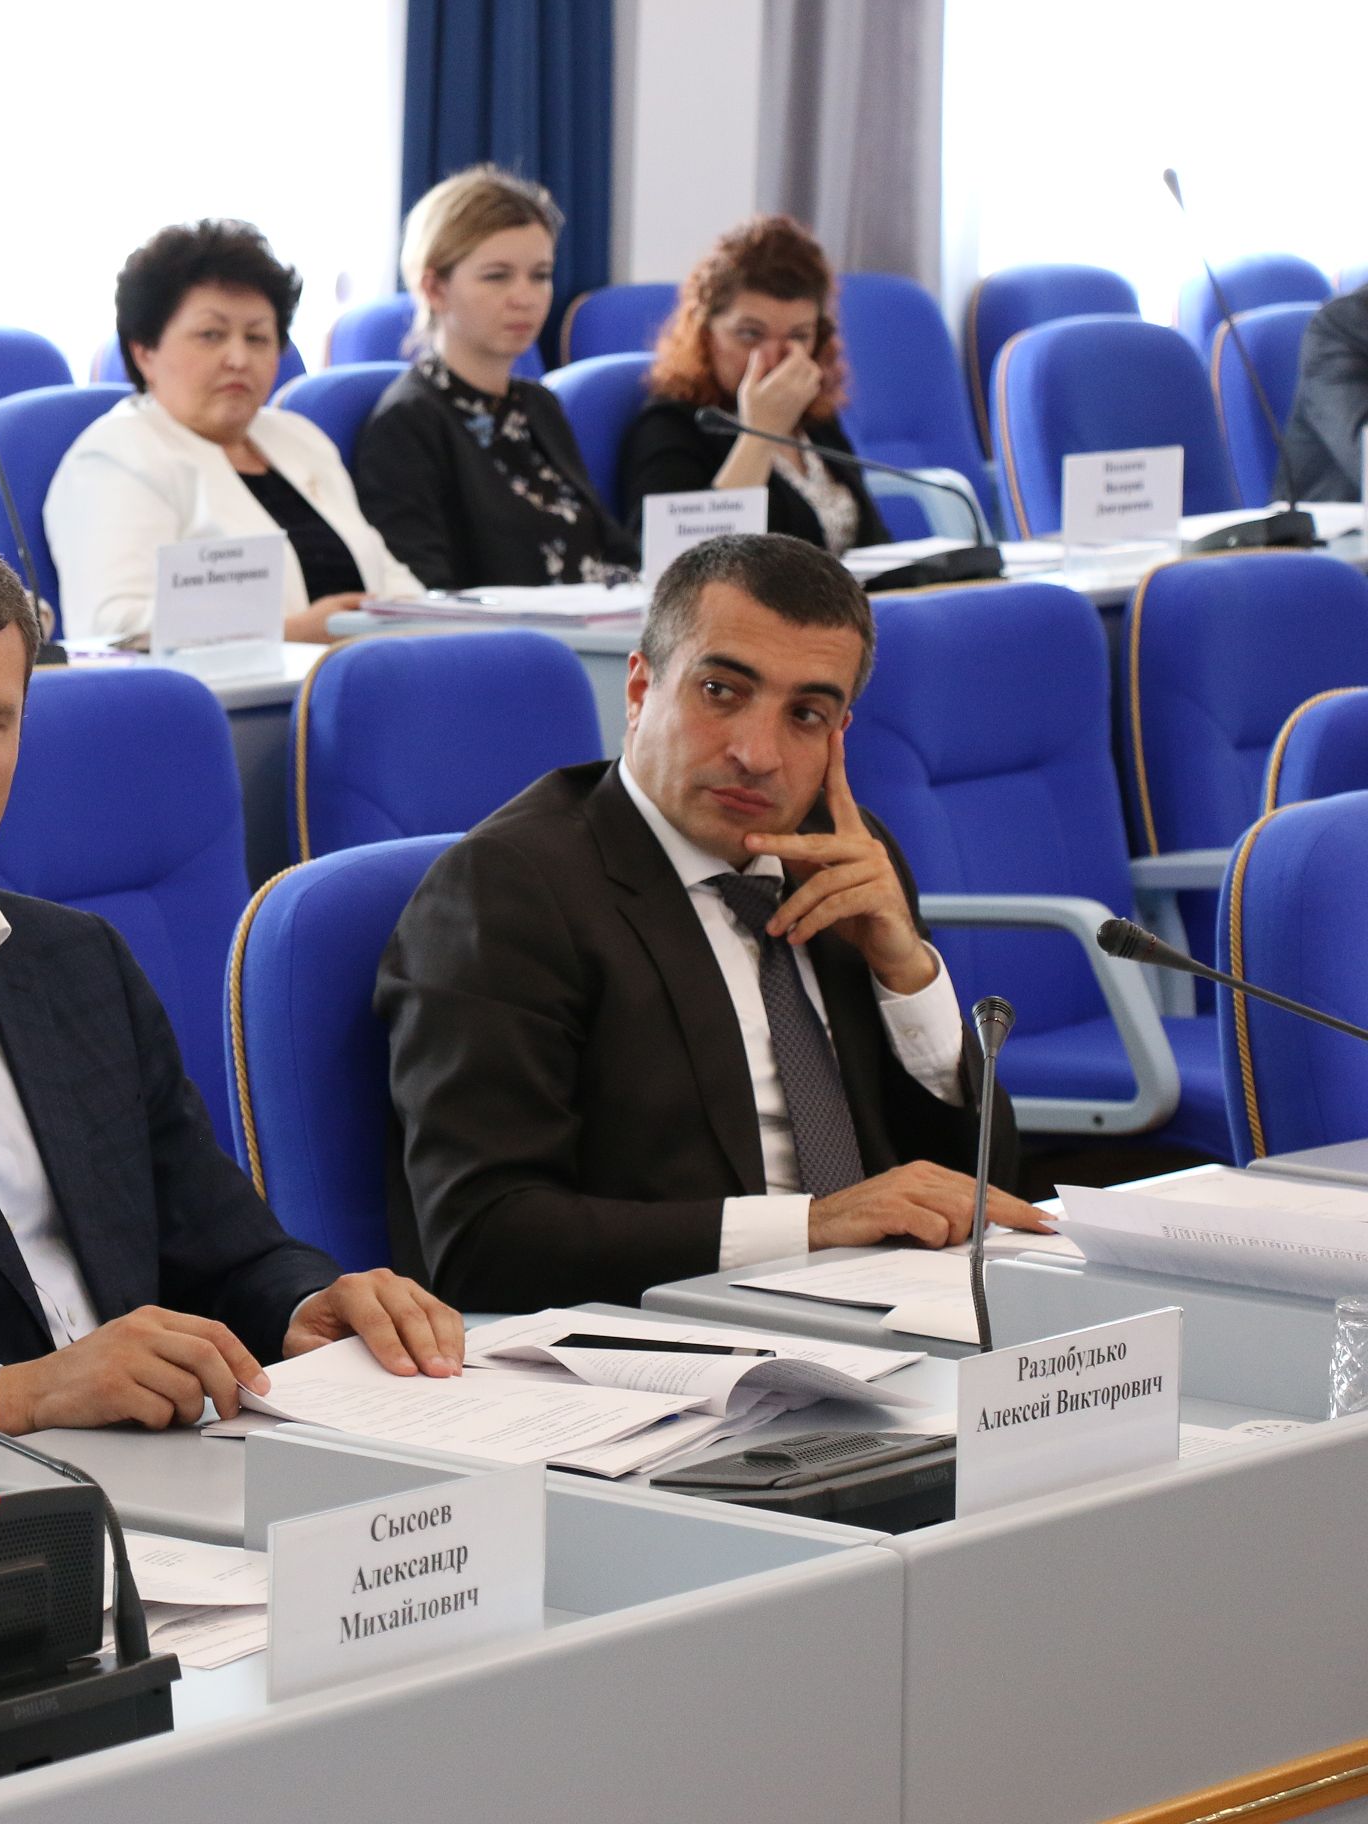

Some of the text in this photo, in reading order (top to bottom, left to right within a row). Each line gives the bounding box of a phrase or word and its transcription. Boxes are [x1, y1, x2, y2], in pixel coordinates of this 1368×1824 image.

[1016, 1342, 1127, 1382] Раздобудько
[976, 1375, 1163, 1433] Алексей Викторович
[370, 1504, 453, 1542] Сысоев
[351, 1544, 468, 1594] Александр
[339, 1586, 479, 1645] Михайлович
